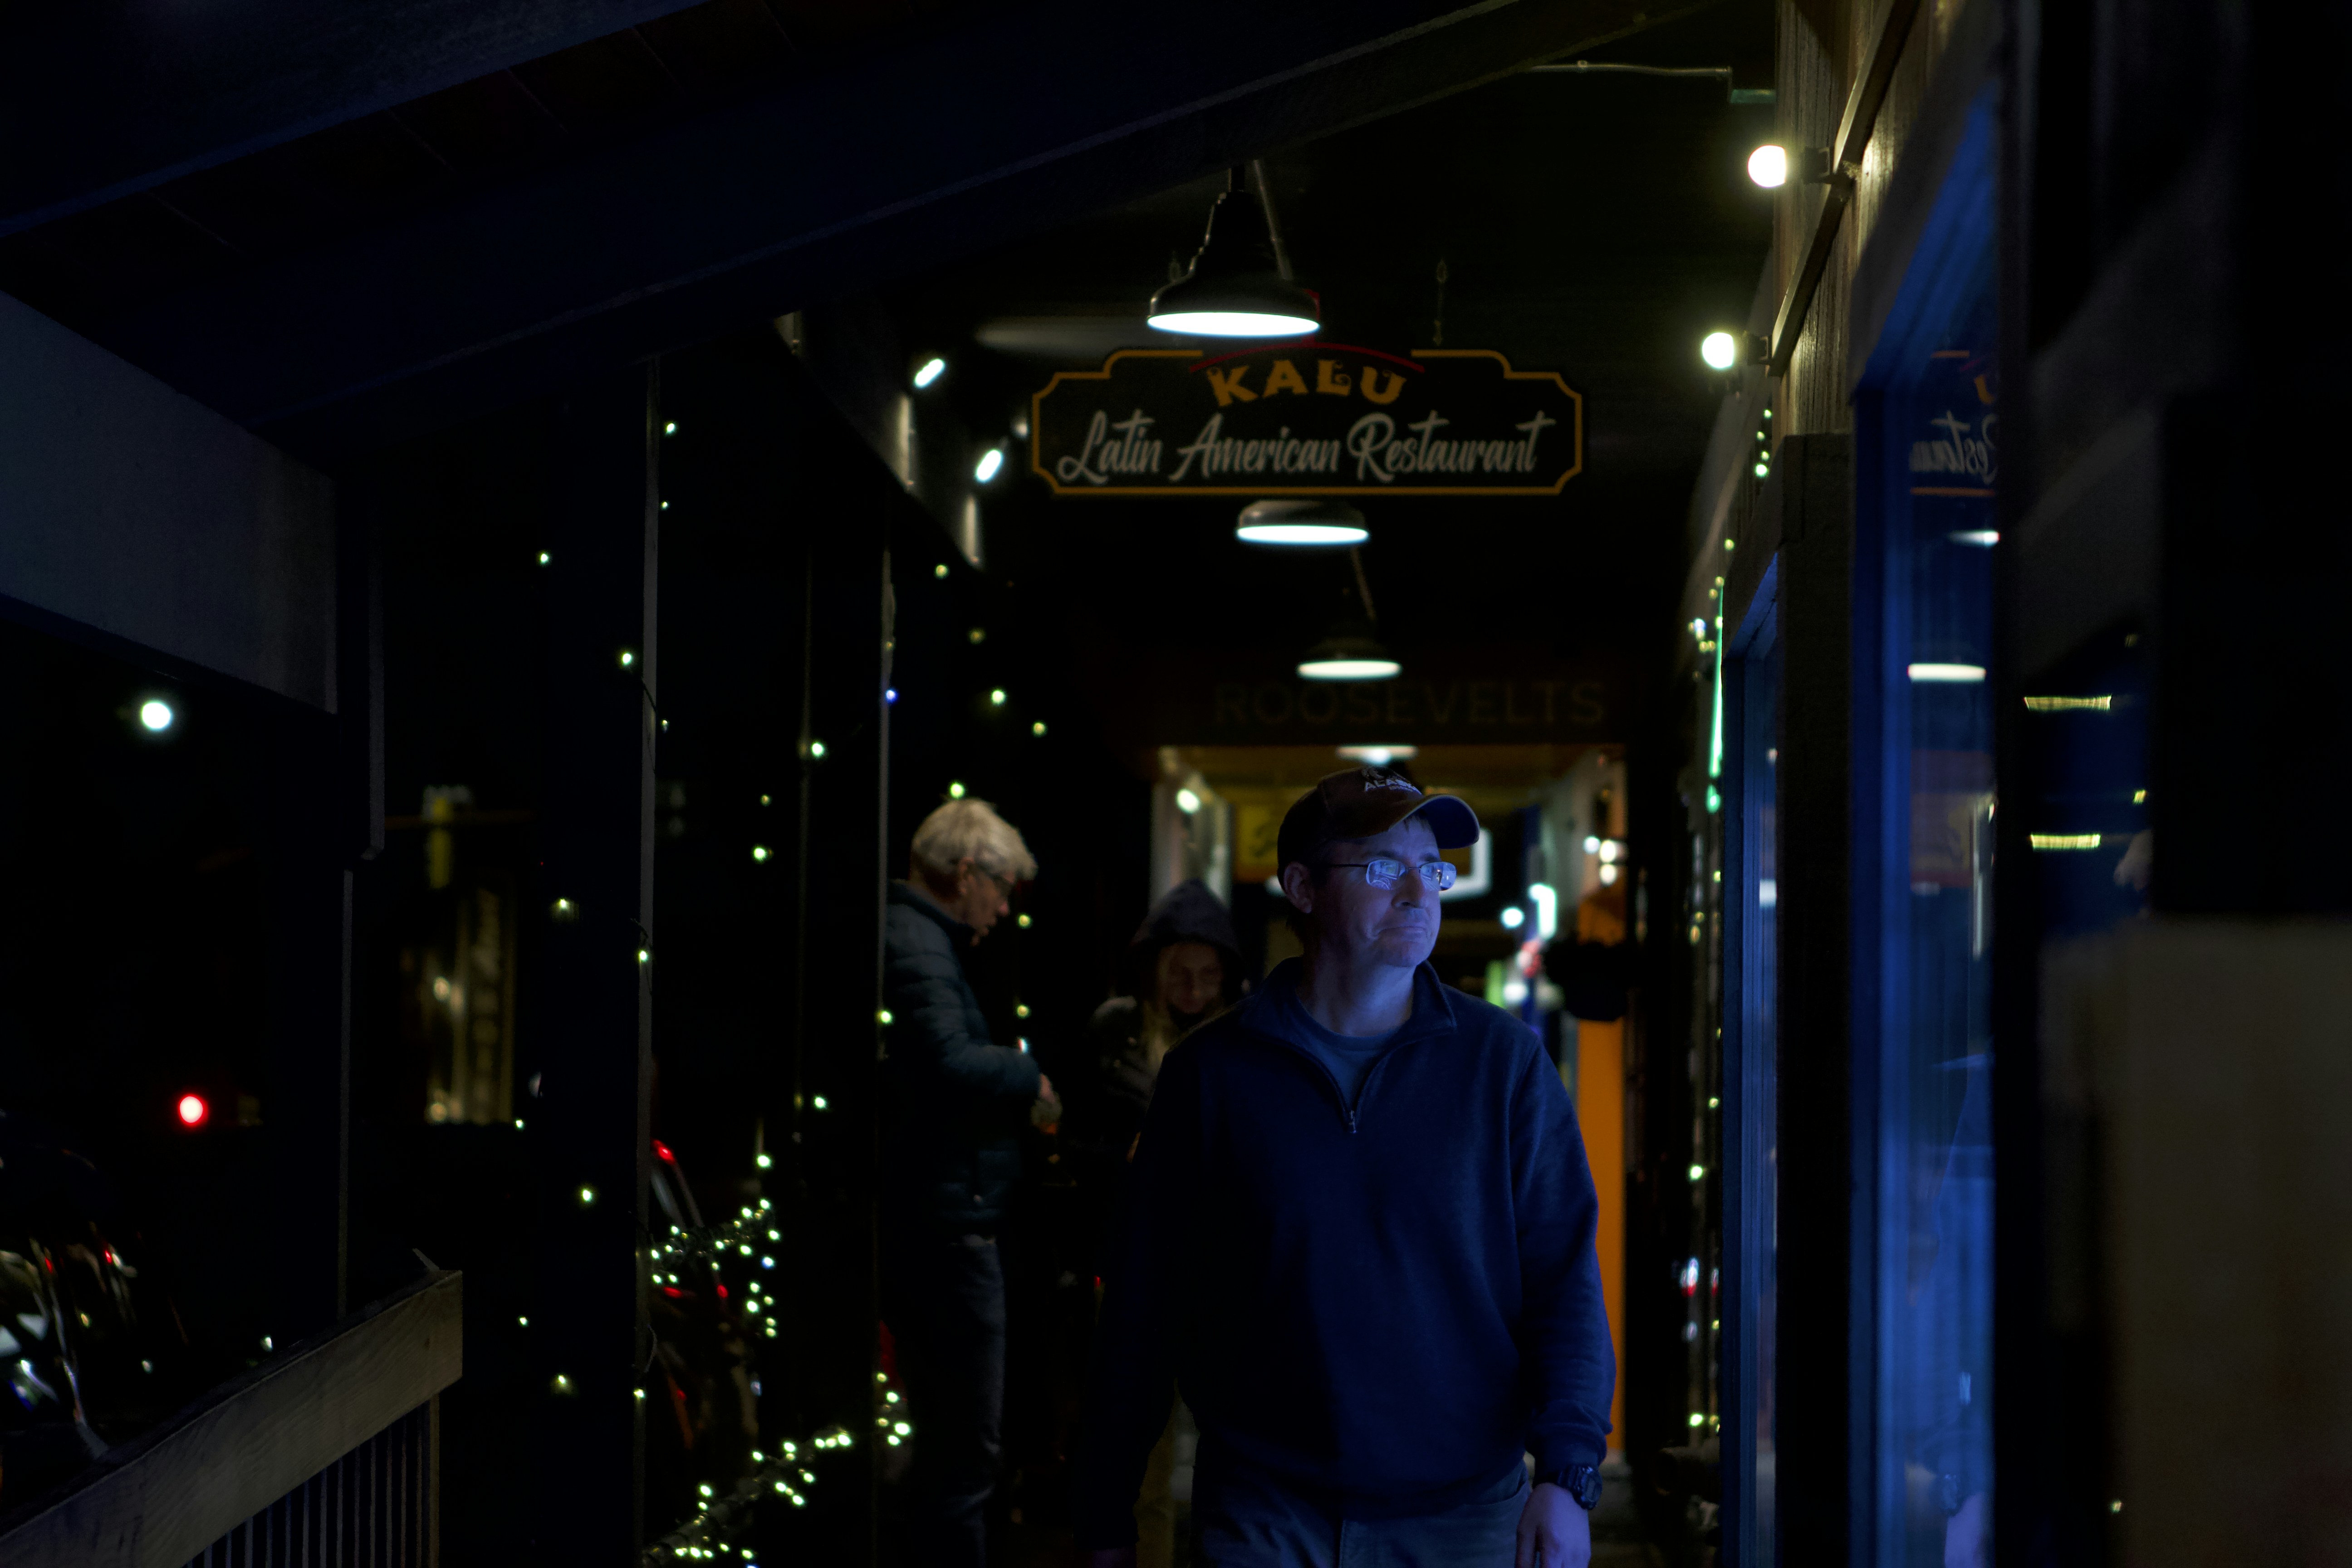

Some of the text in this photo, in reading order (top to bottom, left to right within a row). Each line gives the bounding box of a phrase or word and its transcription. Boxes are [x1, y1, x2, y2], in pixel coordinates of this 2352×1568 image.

[1207, 359, 1406, 407] KALU
[1056, 408, 1557, 485] Latin American Restaurant
[1214, 680, 1607, 725] ROOSEVELTS
